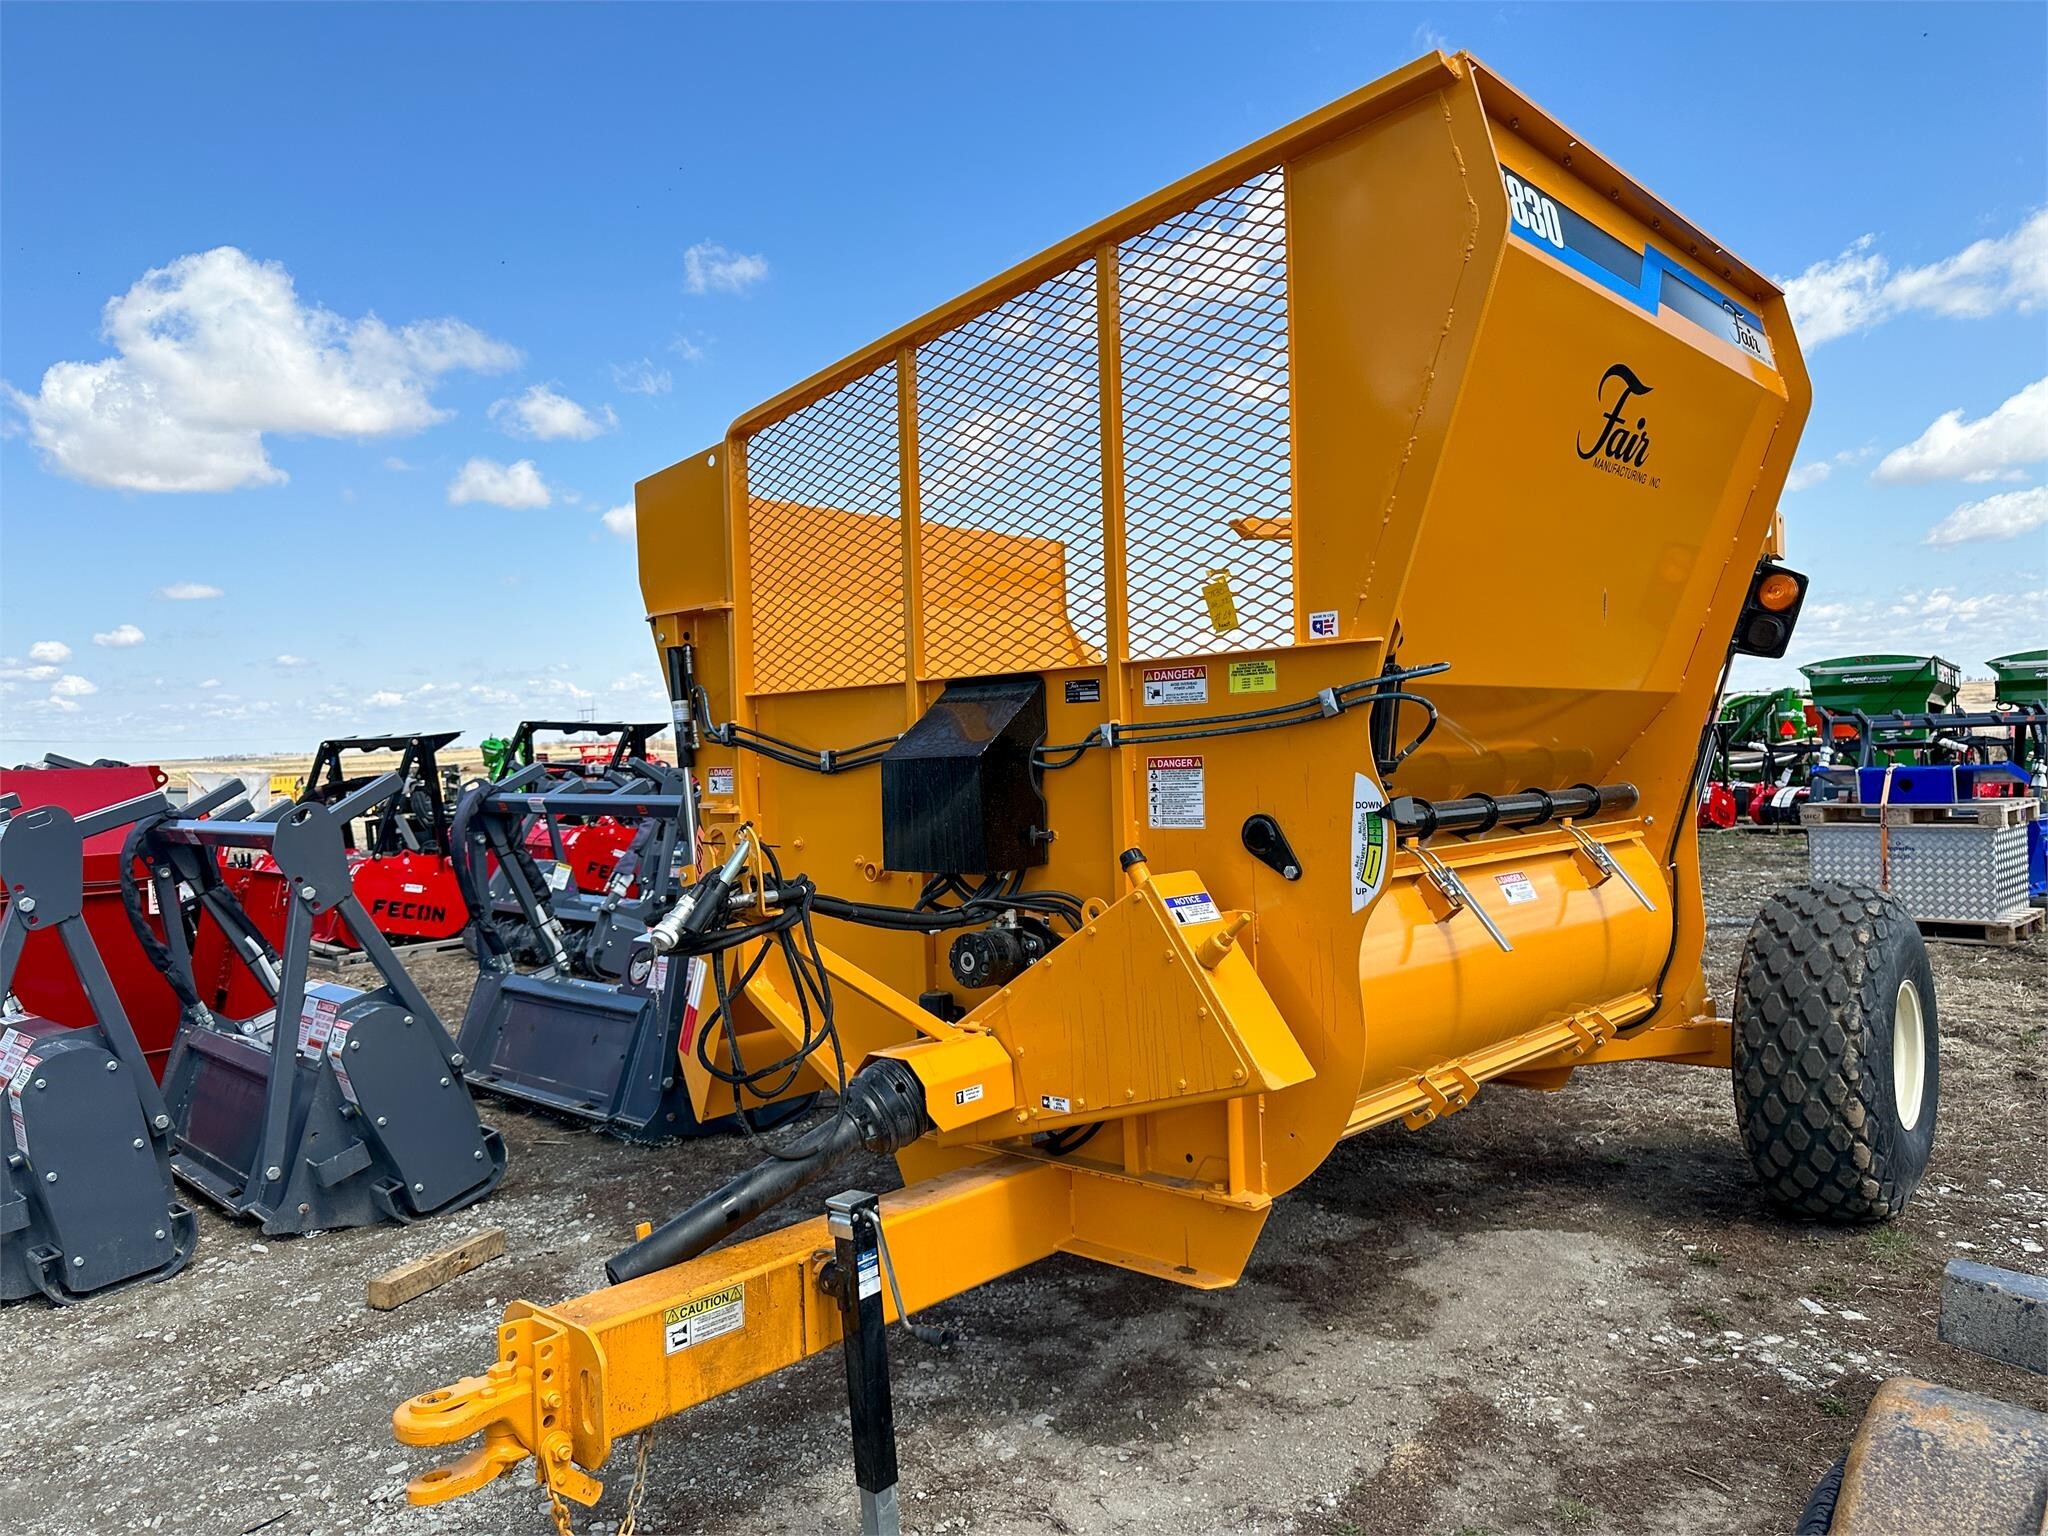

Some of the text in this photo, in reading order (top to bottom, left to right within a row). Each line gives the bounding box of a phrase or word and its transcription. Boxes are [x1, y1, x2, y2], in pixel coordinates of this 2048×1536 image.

[1500, 170, 1565, 249] 830
[1721, 299, 1761, 354] Fair
[1576, 363, 1655, 468] Fair
[1592, 457, 1648, 484] MANUFACTURING
[1153, 669, 1195, 681] DANGER
[714, 767, 734, 776] DANGE
[1157, 759, 1193, 768] DANGER
[1355, 801, 1382, 809] DOWN
[1356, 843, 1366, 880] ADJUSTMENT
[372, 899, 446, 923] FECON
[1173, 895, 1202, 906] NOTICE
[680, 1292, 729, 1318] CAUTION
